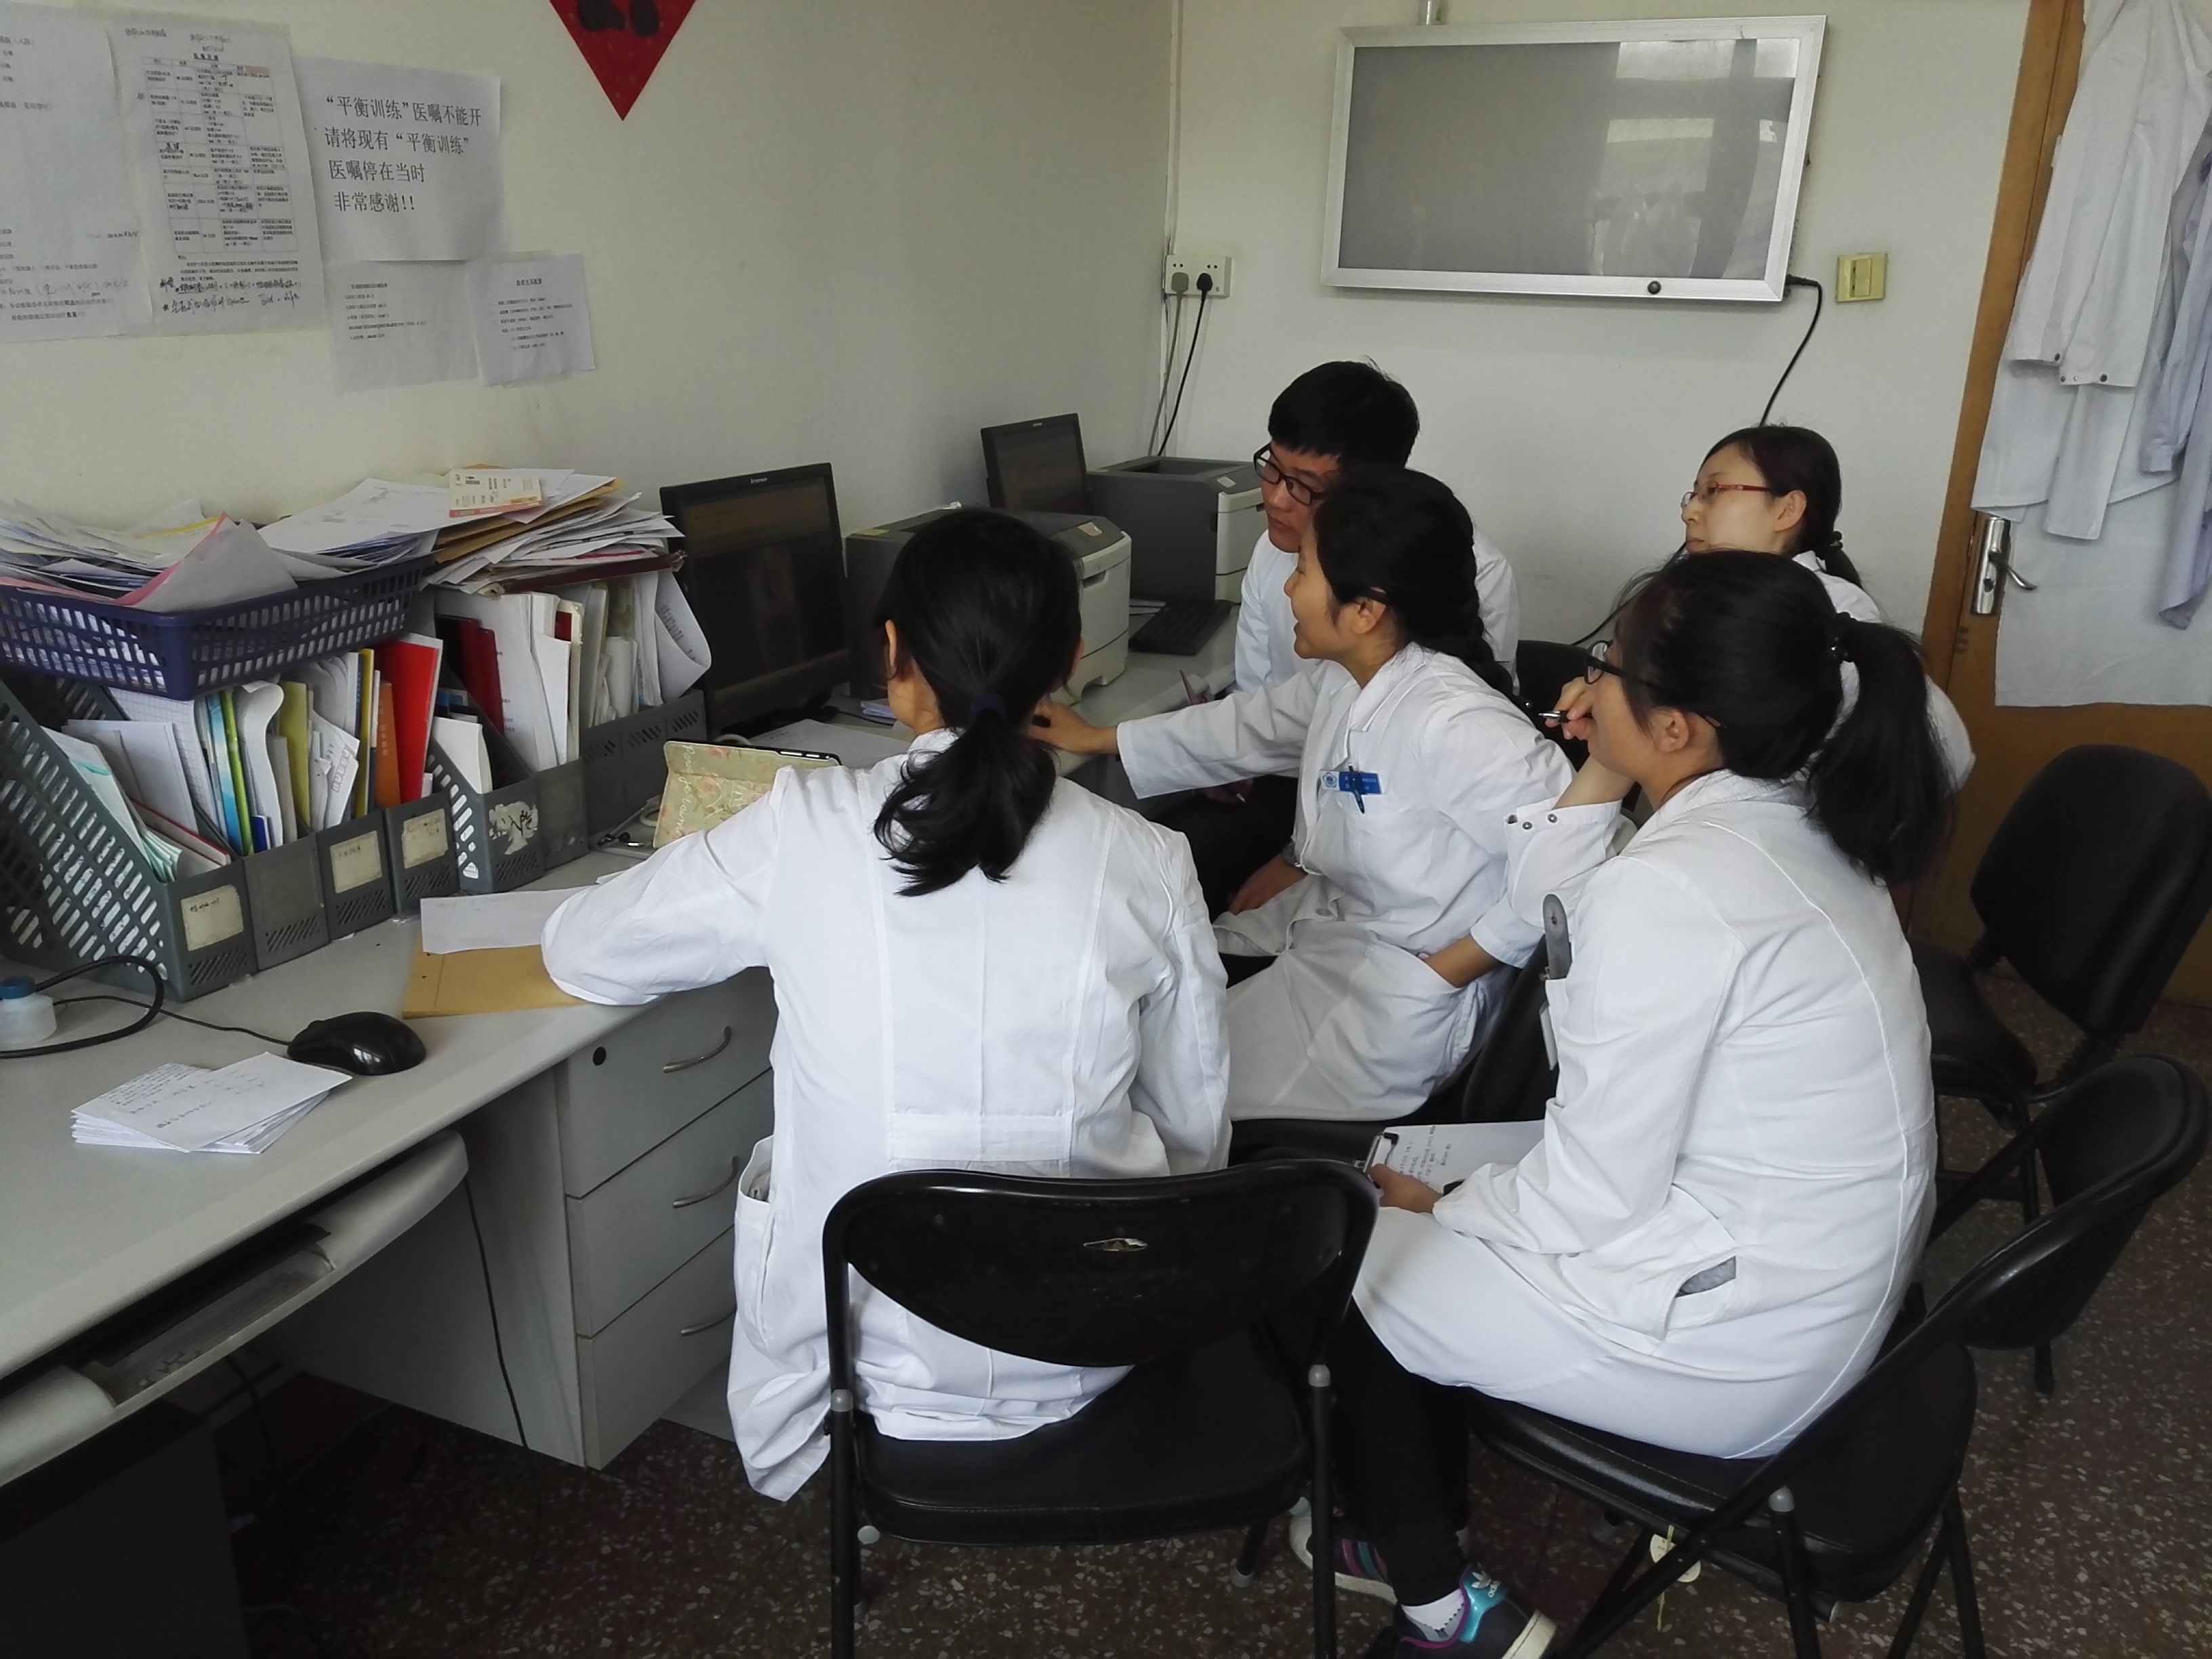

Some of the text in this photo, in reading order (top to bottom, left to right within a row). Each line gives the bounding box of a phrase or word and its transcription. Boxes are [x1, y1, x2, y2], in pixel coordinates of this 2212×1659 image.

[328, 159, 425, 183] 医嘱停在当时
